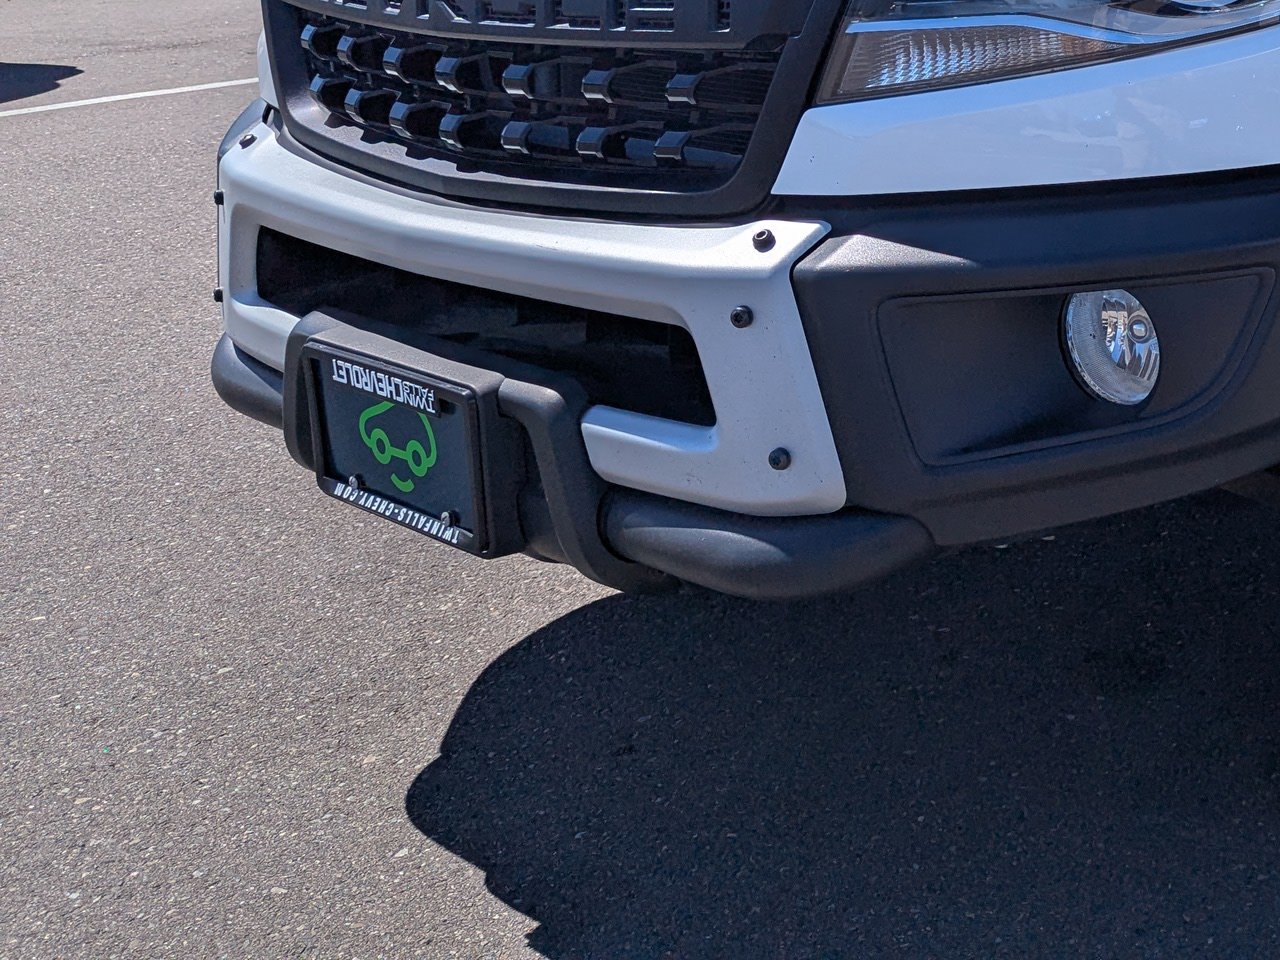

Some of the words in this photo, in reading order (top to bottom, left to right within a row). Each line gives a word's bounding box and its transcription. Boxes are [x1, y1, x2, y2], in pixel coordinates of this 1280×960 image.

[332, 359, 404, 403] CHEVROLET
[403, 381, 435, 402] FALLS
[404, 392, 436, 414] TWIN
[333, 482, 460, 544] TWINFALLS-CHEVY.COM
